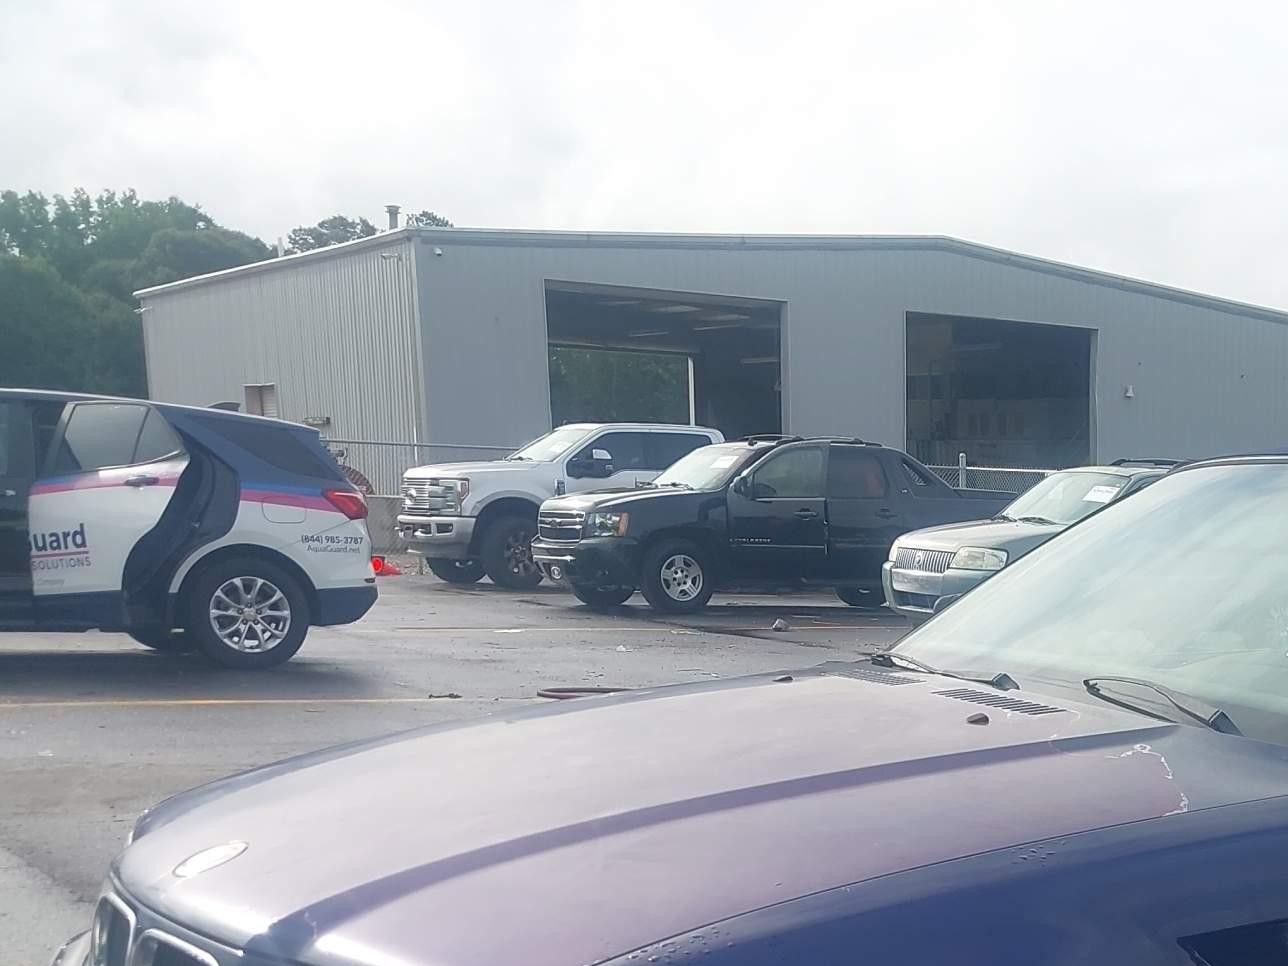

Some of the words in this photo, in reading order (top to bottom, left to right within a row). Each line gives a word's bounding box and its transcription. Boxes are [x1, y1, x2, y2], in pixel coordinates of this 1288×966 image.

[29, 523, 87, 552] uard
[301, 535, 323, 544] (844)
[324, 535, 363, 545] 985-3787
[32, 557, 92, 571] SOLUTIONS
